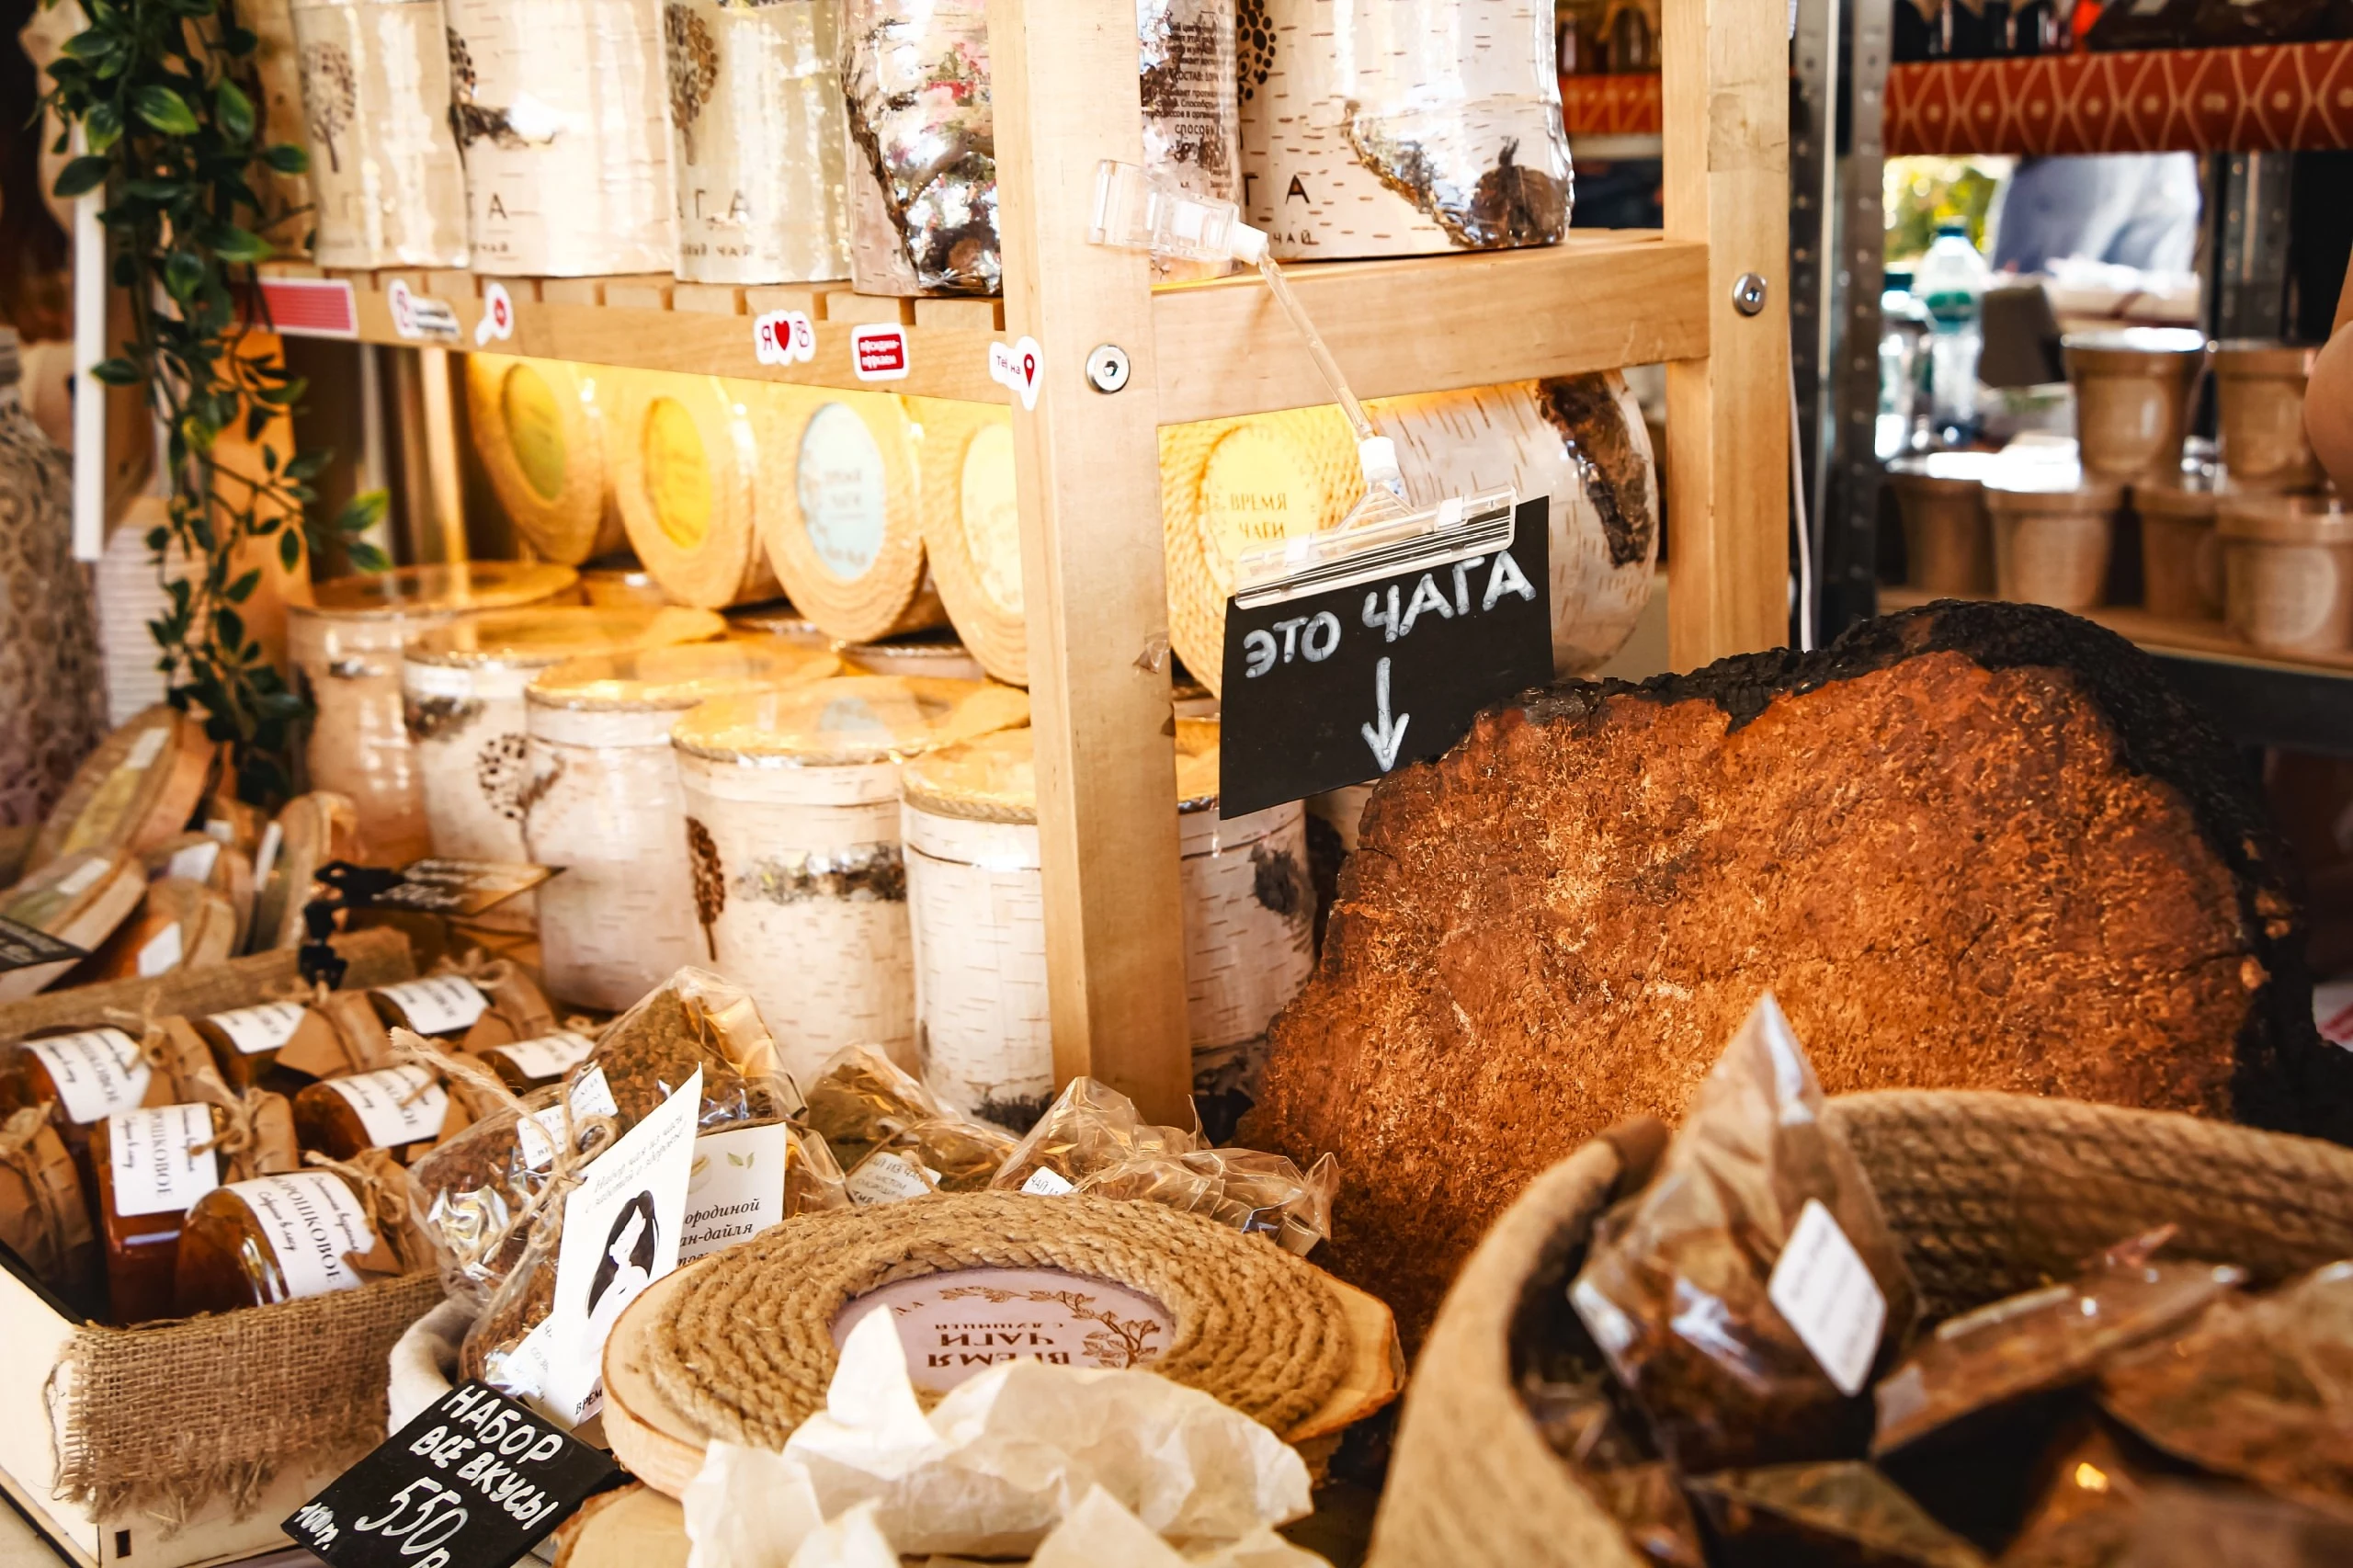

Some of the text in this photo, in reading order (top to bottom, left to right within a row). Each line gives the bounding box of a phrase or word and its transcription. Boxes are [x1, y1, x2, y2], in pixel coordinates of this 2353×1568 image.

[1230, 492, 1288, 511] ВРЕМЯ
[1239, 521, 1286, 540] ЧАГИ
[1244, 550, 1537, 678] ЭТО ЧАГА
[684, 1198, 761, 1229] ородиной
[679, 1222, 754, 1247] ан-дайля
[939, 1332, 1054, 1347] ЧАГИ
[574, 1386, 604, 1415] ВРЕМ
[441, 1384, 564, 1464] НАБОР
[408, 1426, 559, 1531] ВСЕ ВКУСЫ
